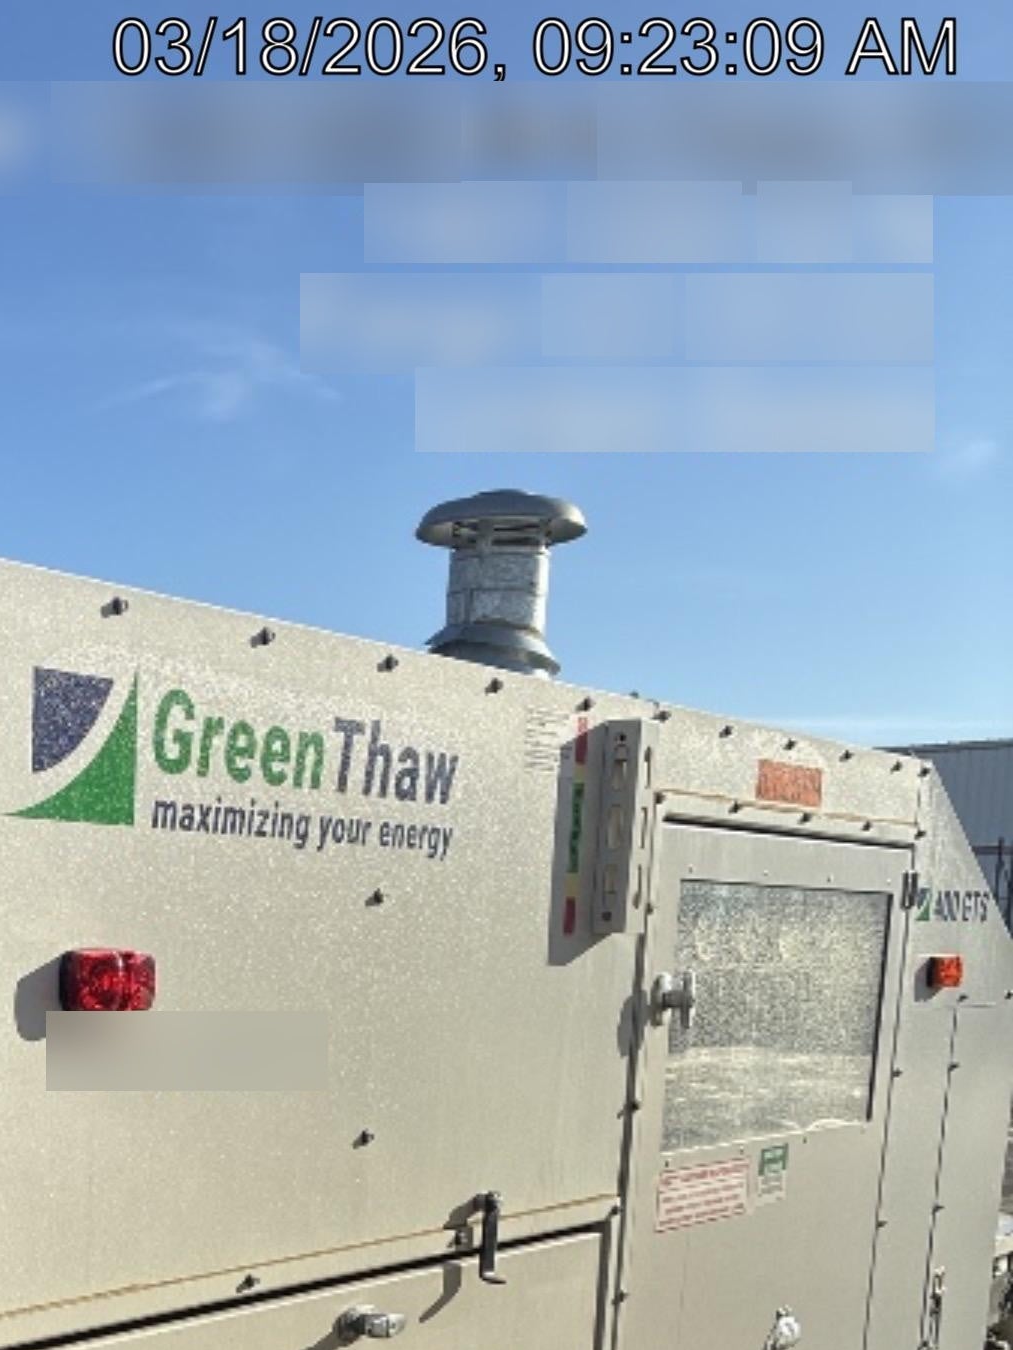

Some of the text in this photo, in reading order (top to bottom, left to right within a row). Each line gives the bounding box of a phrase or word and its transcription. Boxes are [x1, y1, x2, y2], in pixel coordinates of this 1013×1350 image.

[151, 796, 454, 861] maximizing your energy
